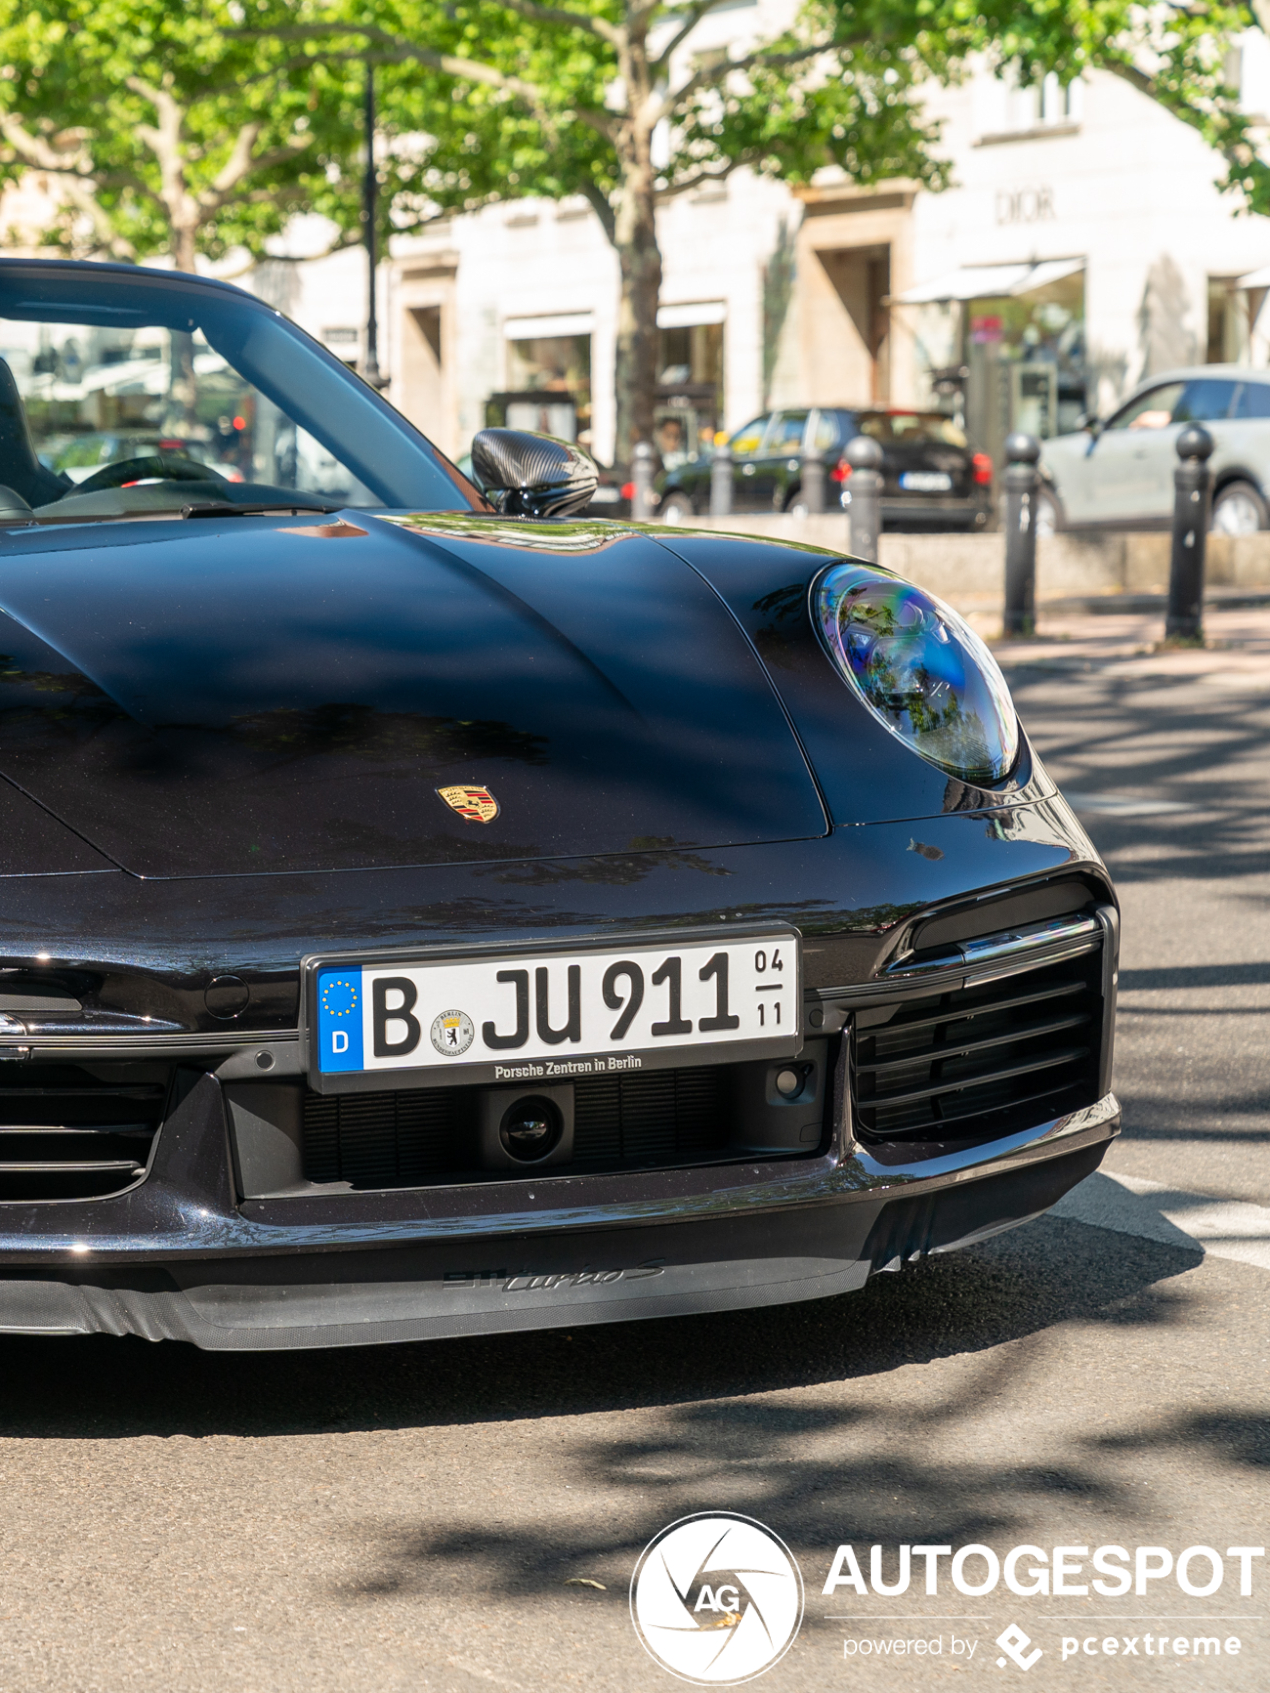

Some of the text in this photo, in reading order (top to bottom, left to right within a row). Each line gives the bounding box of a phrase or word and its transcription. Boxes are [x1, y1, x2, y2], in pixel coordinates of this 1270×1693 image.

[994, 184, 1057, 226] DIOR
[754, 949, 783, 973] 04
[372, 952, 740, 1058] B JU 911
[439, 1011, 462, 1020] BERLIN
[757, 1001, 781, 1026] 11
[332, 1030, 349, 1054] D
[494, 1055, 642, 1079] Porsche Zentren in Berlin
[625, 1257, 666, 1281] S
